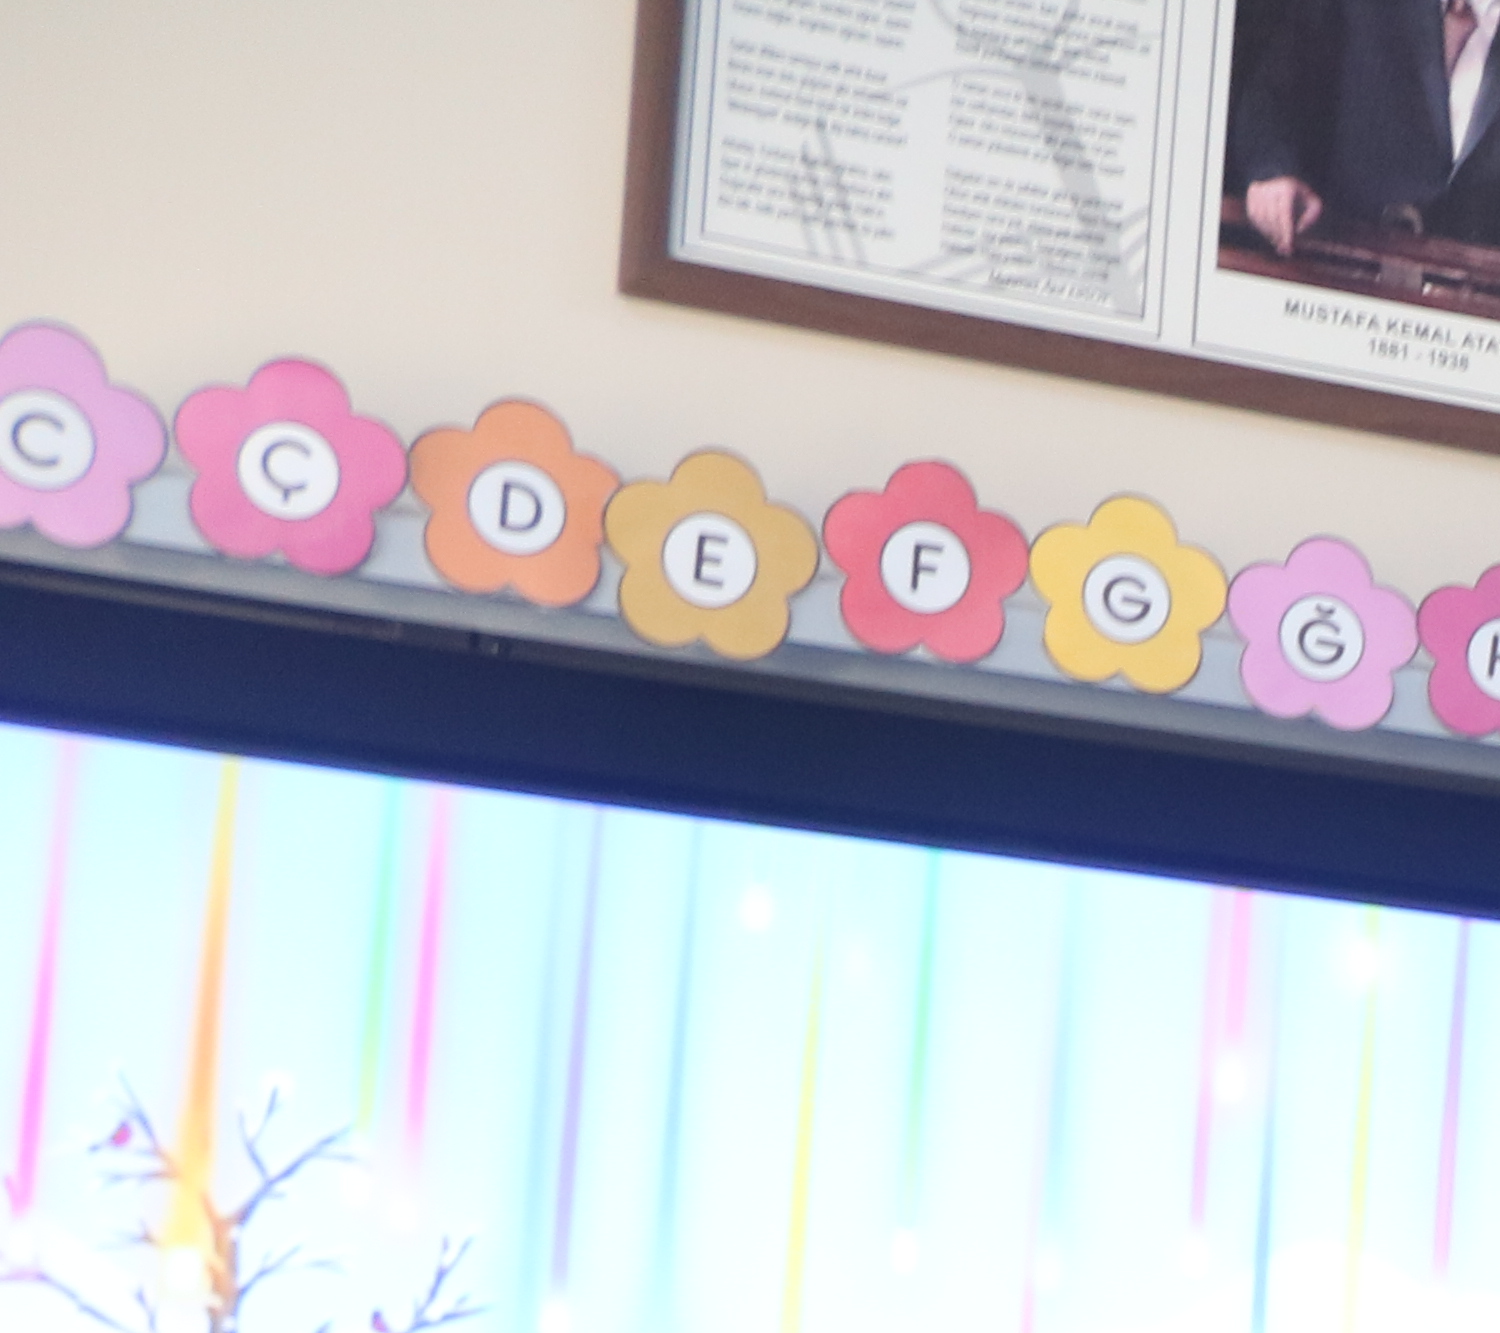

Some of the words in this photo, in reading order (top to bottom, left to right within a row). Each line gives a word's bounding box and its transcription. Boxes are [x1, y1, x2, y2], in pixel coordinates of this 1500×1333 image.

[1284, 297, 1380, 331] MUSTAFA
[1387, 318, 1453, 343] KEMAL
[11, 411, 65, 468] C
[259, 438, 311, 504] Ç
[498, 480, 543, 533] D
[693, 533, 728, 587] E
[910, 542, 943, 592] F
[1102, 575, 1152, 625] G
[1297, 605, 1346, 666] Ğ
